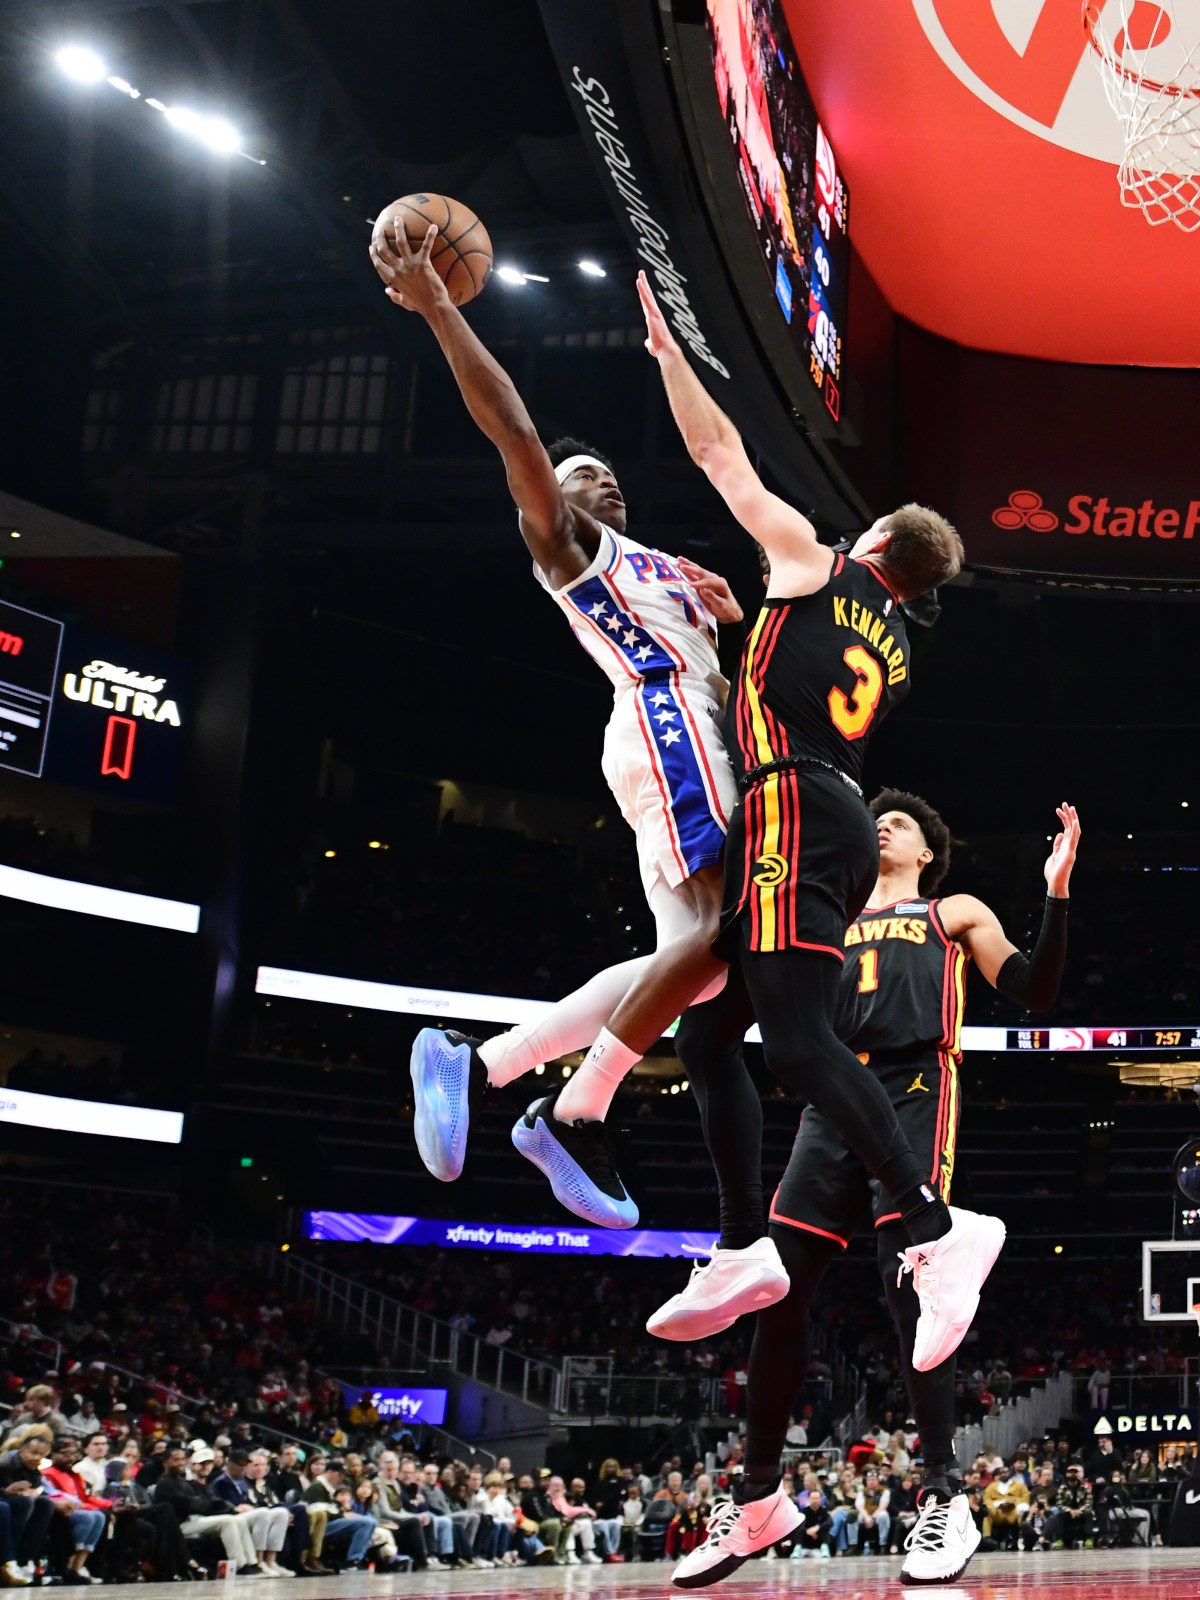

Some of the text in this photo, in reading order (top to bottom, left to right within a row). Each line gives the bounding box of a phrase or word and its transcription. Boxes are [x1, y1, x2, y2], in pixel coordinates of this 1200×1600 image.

[833, 596, 907, 686] KENNARD
[63, 673, 181, 727] ULTRA
[827, 644, 883, 741] 3
[844, 917, 928, 948] AWKS
[858, 948, 878, 994] 1
[407, 997, 450, 1008] georgia
[1018, 1031, 1040, 1040] FLS 2
[1018, 1040, 1040, 1049] TOL 6
[1107, 1031, 1181, 1047] 41 7:57
[446, 1224, 591, 1248] xfinity Imagine That
[1117, 1414, 1192, 1433] DELTA
